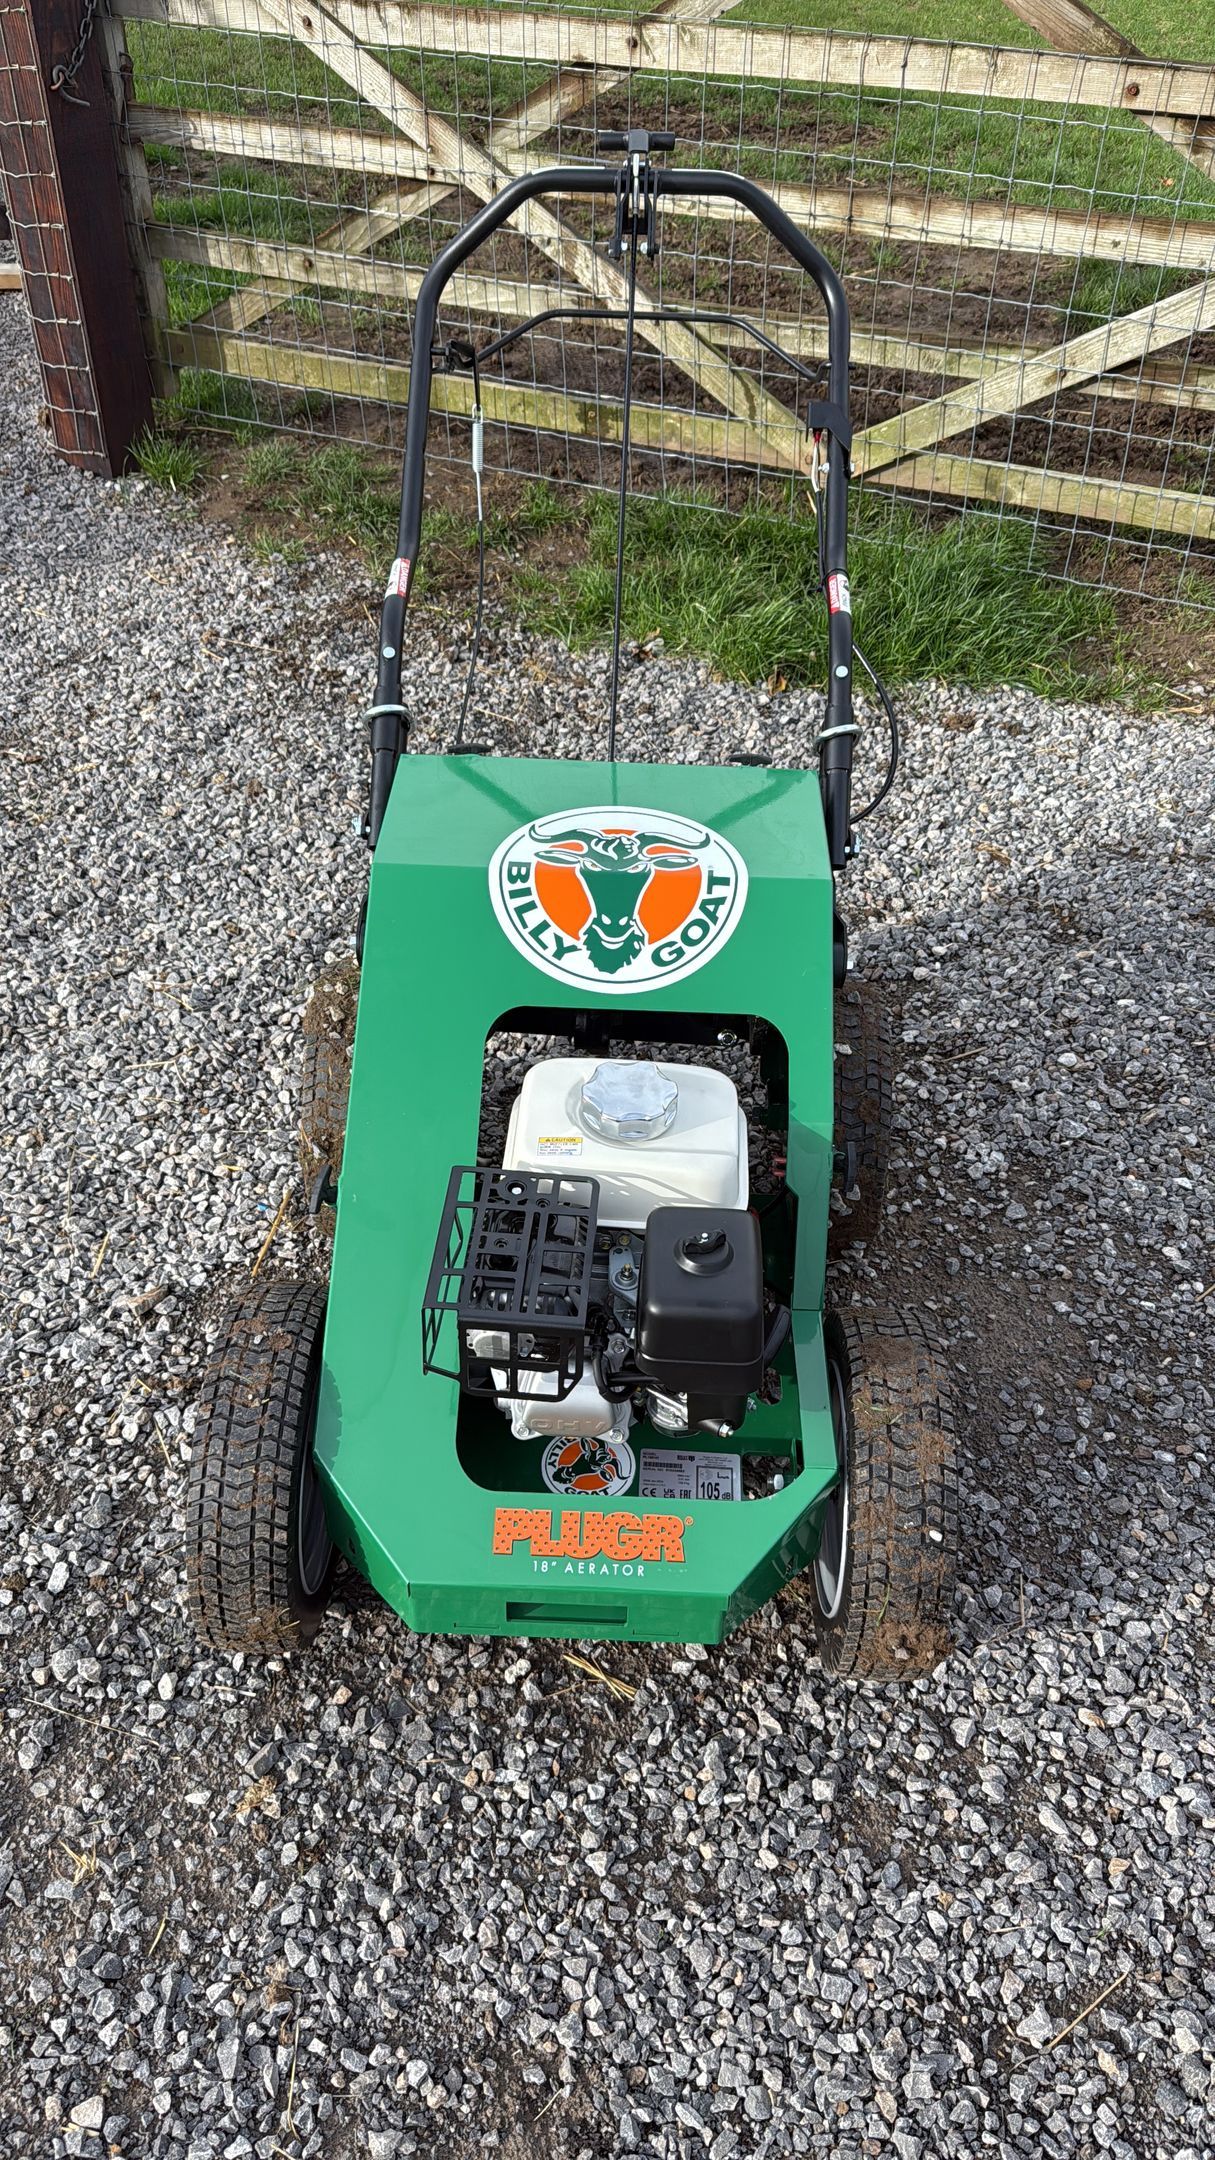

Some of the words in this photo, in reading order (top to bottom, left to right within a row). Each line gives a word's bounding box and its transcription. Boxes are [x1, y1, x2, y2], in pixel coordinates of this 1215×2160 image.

[507, 861, 582, 961] BILLY
[651, 870, 731, 968] GOAT
[700, 1481, 720, 1500] 105
[564, 1562, 645, 1577] AERATOR
